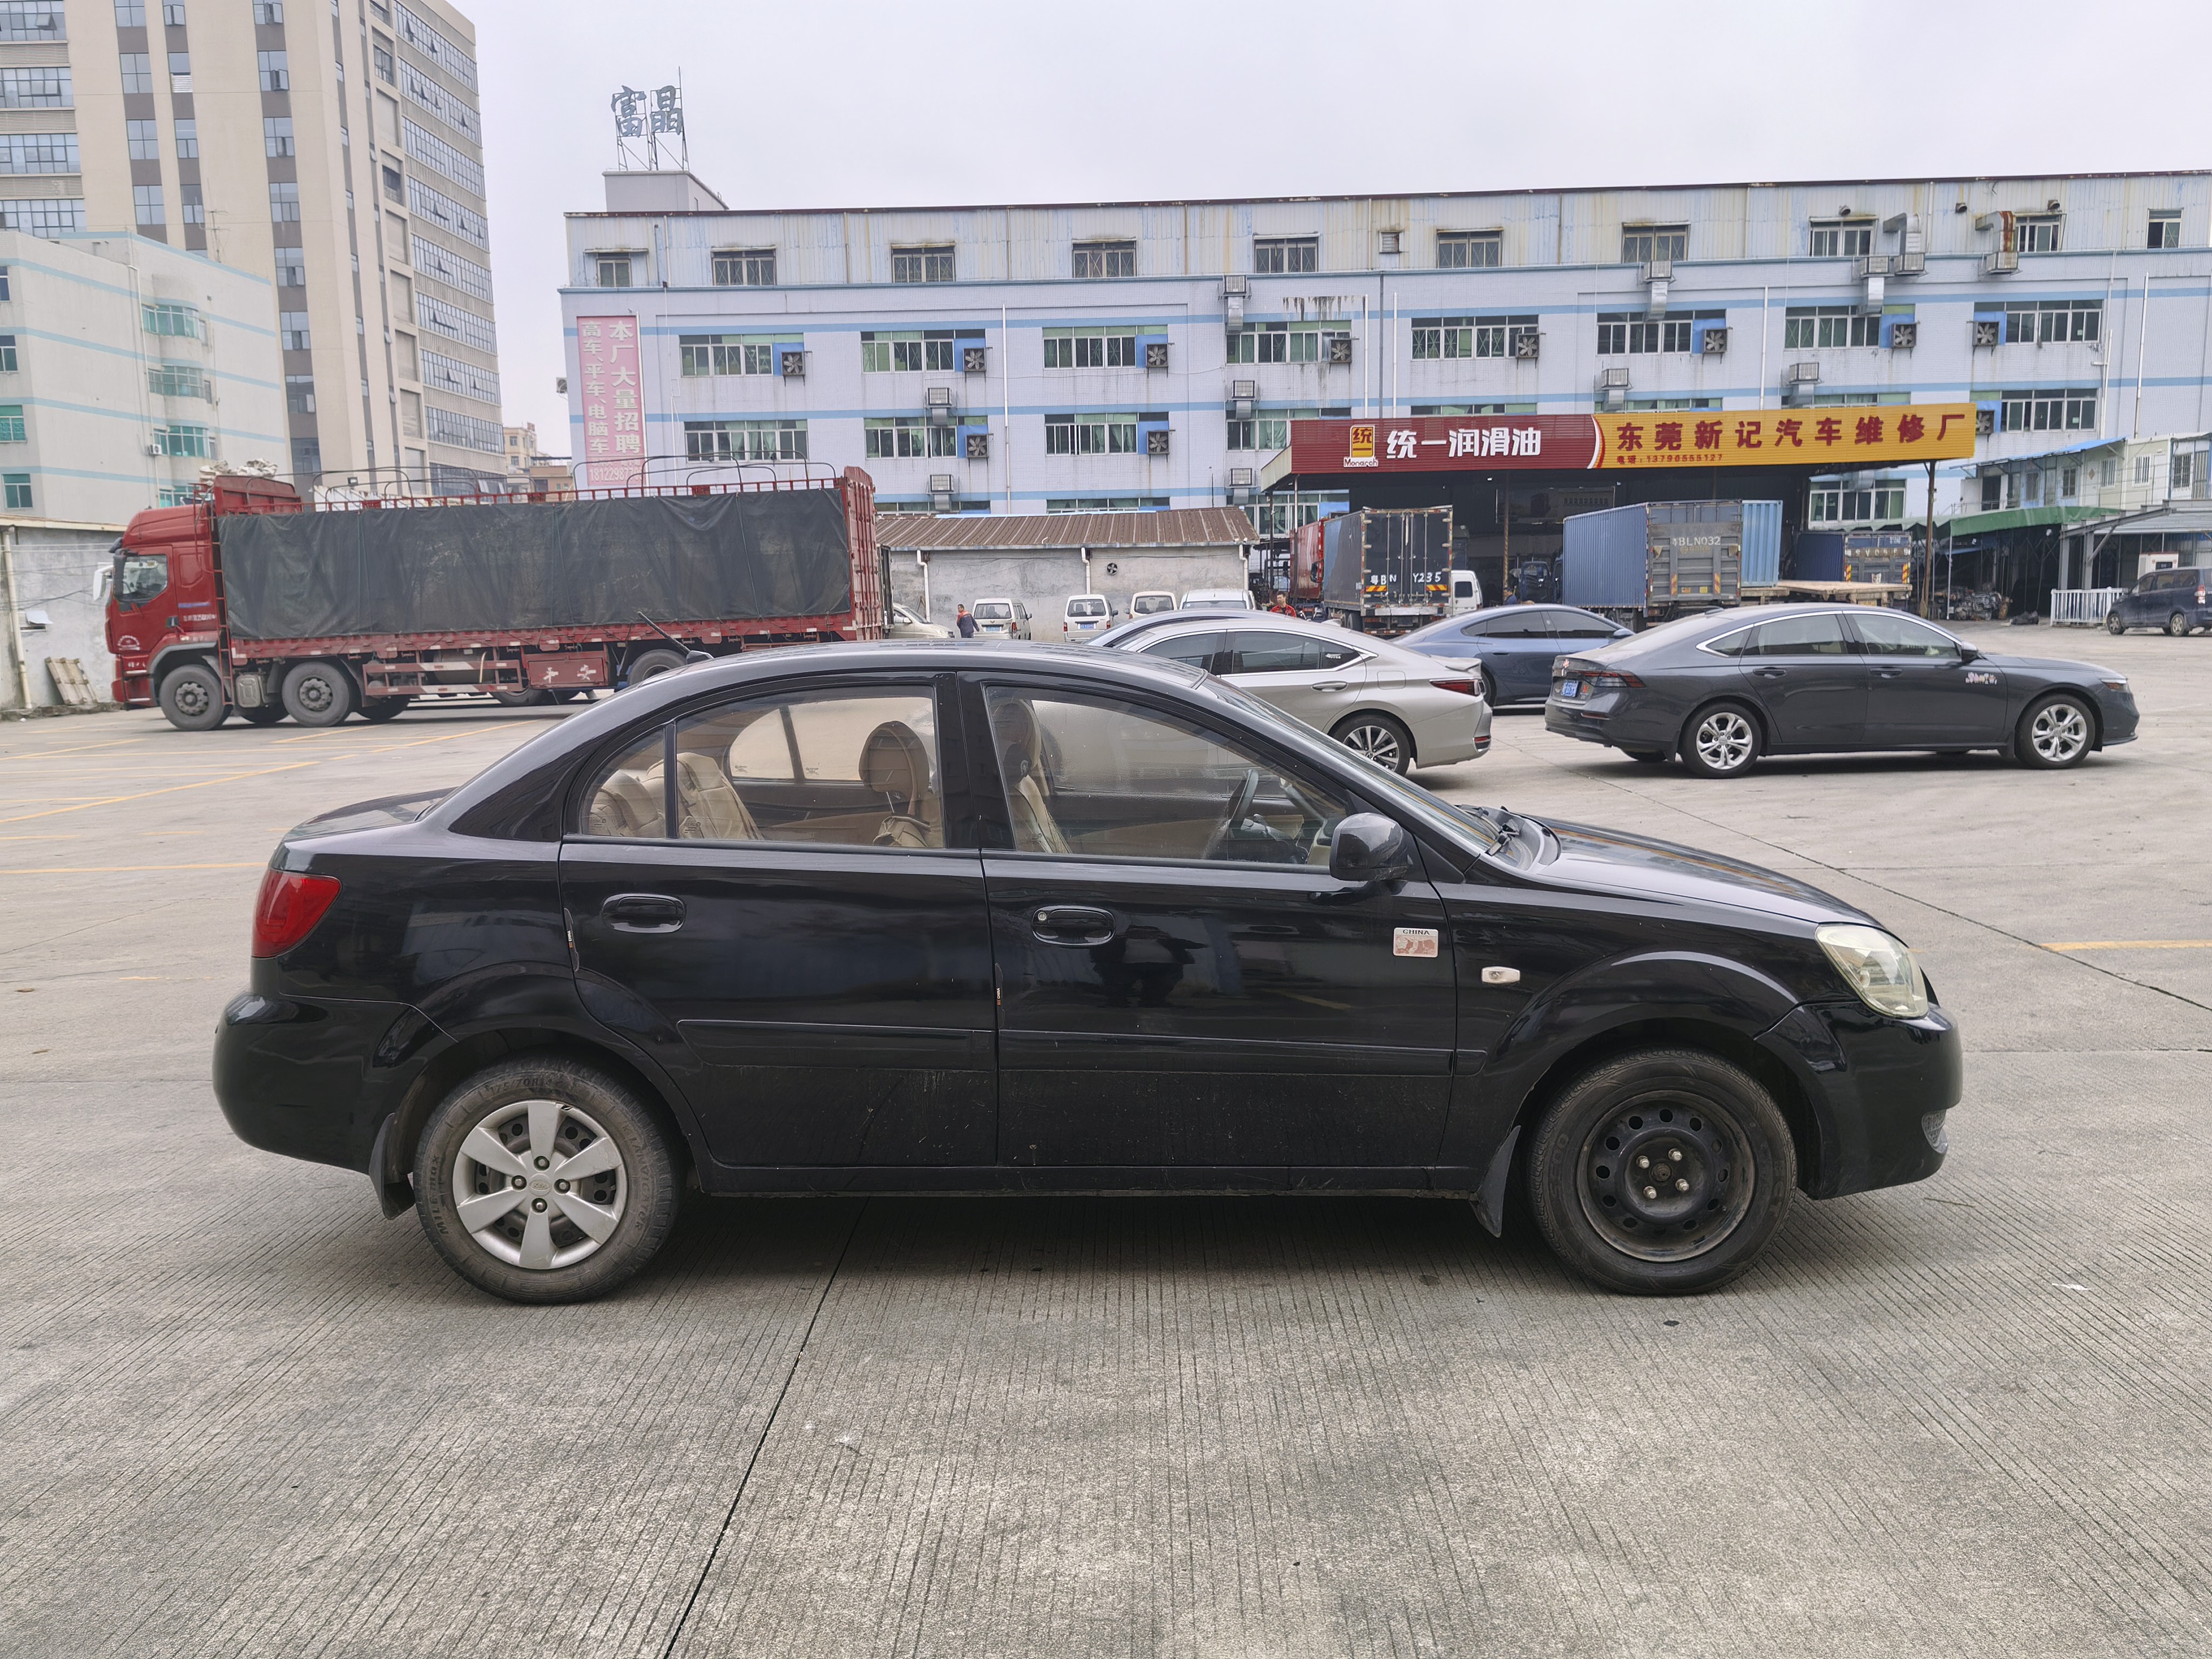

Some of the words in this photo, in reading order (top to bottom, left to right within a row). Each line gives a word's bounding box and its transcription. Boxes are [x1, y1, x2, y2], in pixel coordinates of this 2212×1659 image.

[611, 85, 683, 138] 富晶
[609, 321, 641, 454] 本厂大量招聘
[1386, 427, 1541, 459] 统一润滑油
[1616, 414, 1966, 451] 东莞新记汽车维修厂
[1344, 458, 1378, 467] Monarch
